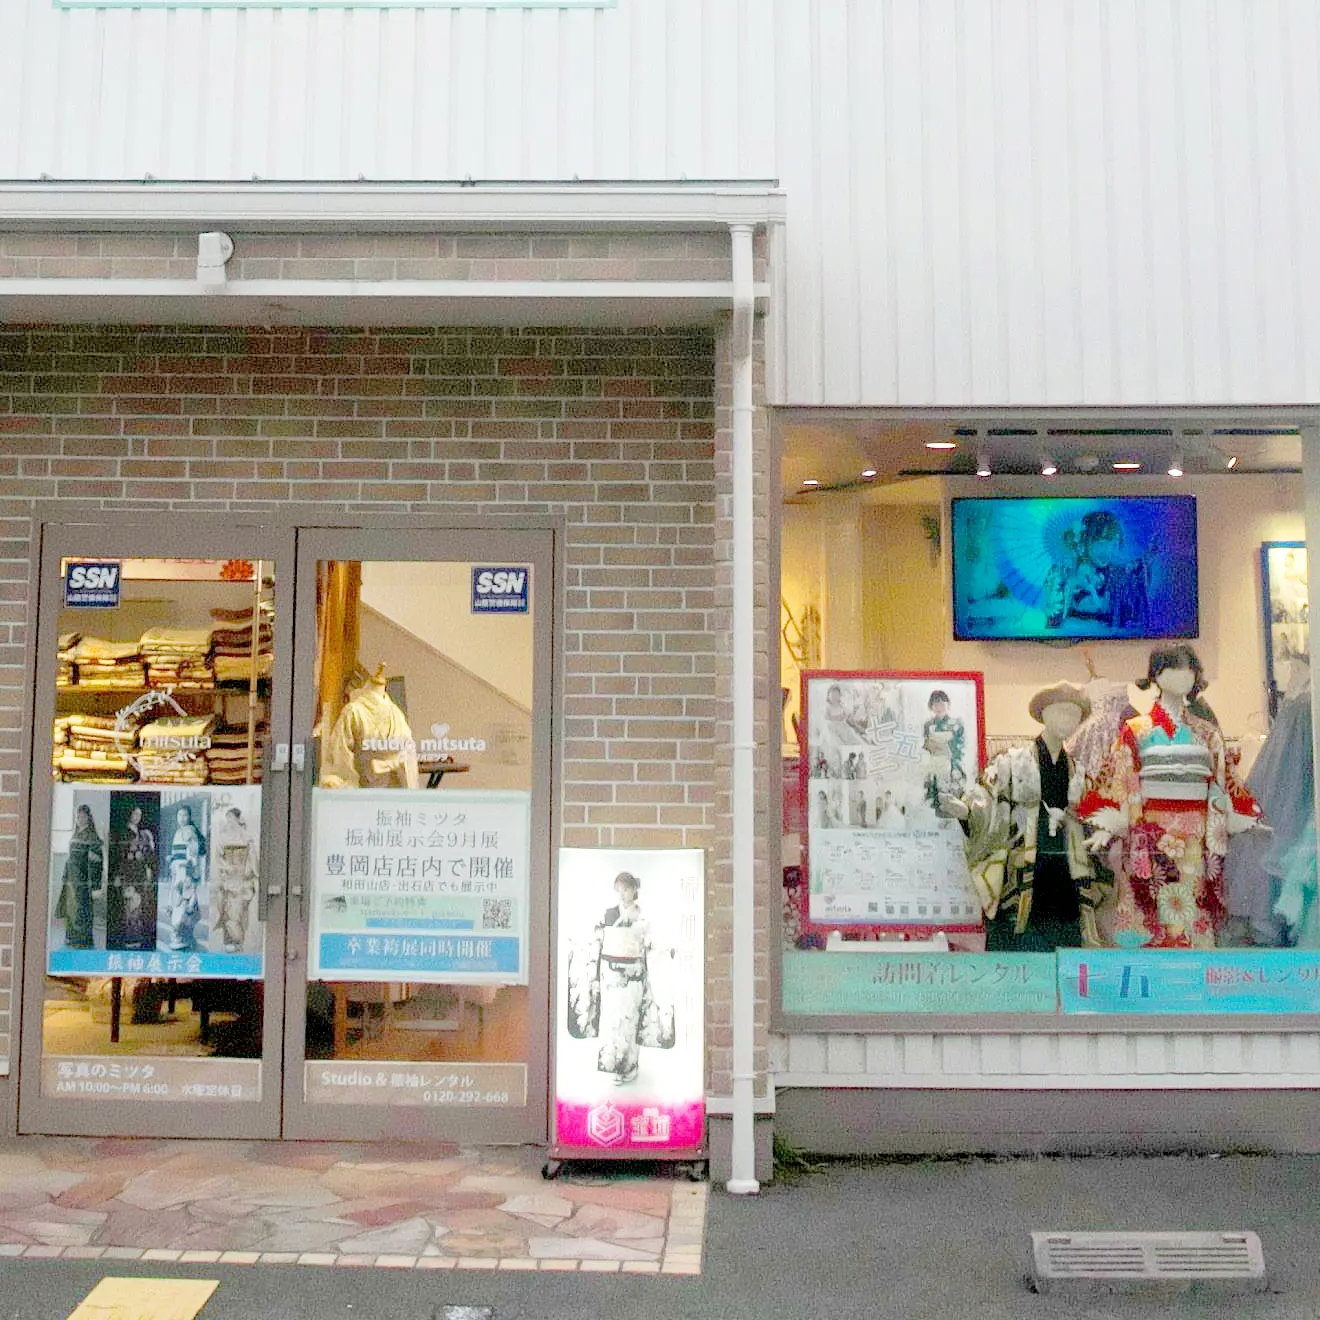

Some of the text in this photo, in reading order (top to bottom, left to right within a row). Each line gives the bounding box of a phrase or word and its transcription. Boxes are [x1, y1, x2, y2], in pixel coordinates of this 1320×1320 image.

[68, 566, 118, 589] SSN
[476, 571, 526, 594] SSN
[362, 736, 488, 751] studio mitsuta
[376, 808, 469, 828] 振袖ミツタ
[345, 828, 500, 850] 振袖展示会9月展
[326, 853, 514, 879] 豊岡店店内で開催
[872, 961, 1034, 985] 訪問着レンタル
[57, 1061, 155, 1078] 写真のミツタ
[321, 1071, 372, 1086] Studio
[375, 1073, 387, 1086] &
